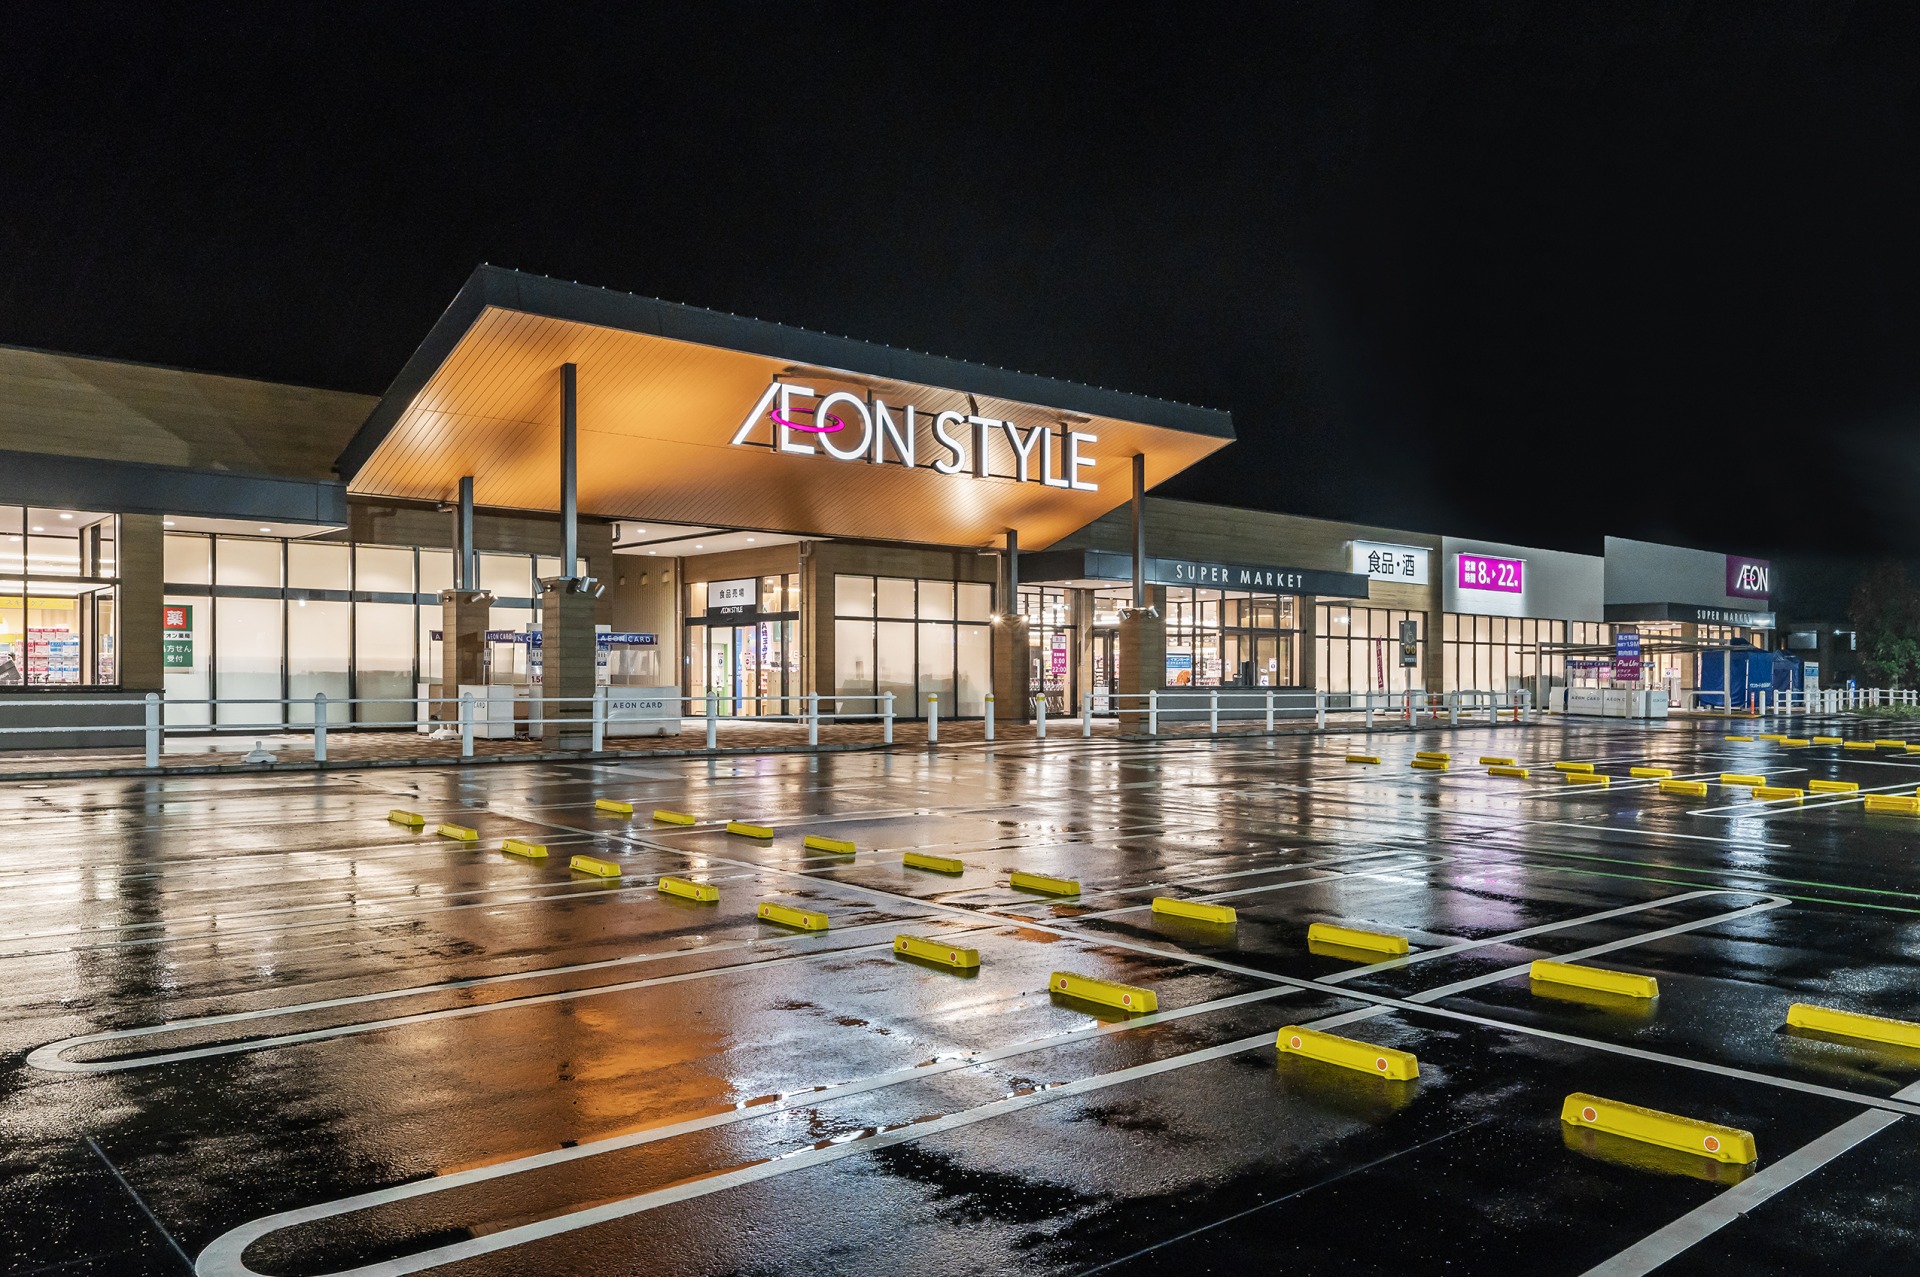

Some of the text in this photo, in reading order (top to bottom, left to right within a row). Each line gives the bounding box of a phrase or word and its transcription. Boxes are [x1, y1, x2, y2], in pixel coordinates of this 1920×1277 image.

[932, 411, 1098, 492] STYLE
[1176, 564, 1303, 588] SUPER MARKET
[166, 610, 184, 626] 薬
[1697, 609, 1720, 621] SUPER
[600, 634, 625, 642] AEON
[166, 654, 184, 663] 受付
[639, 701, 663, 709] CARD
